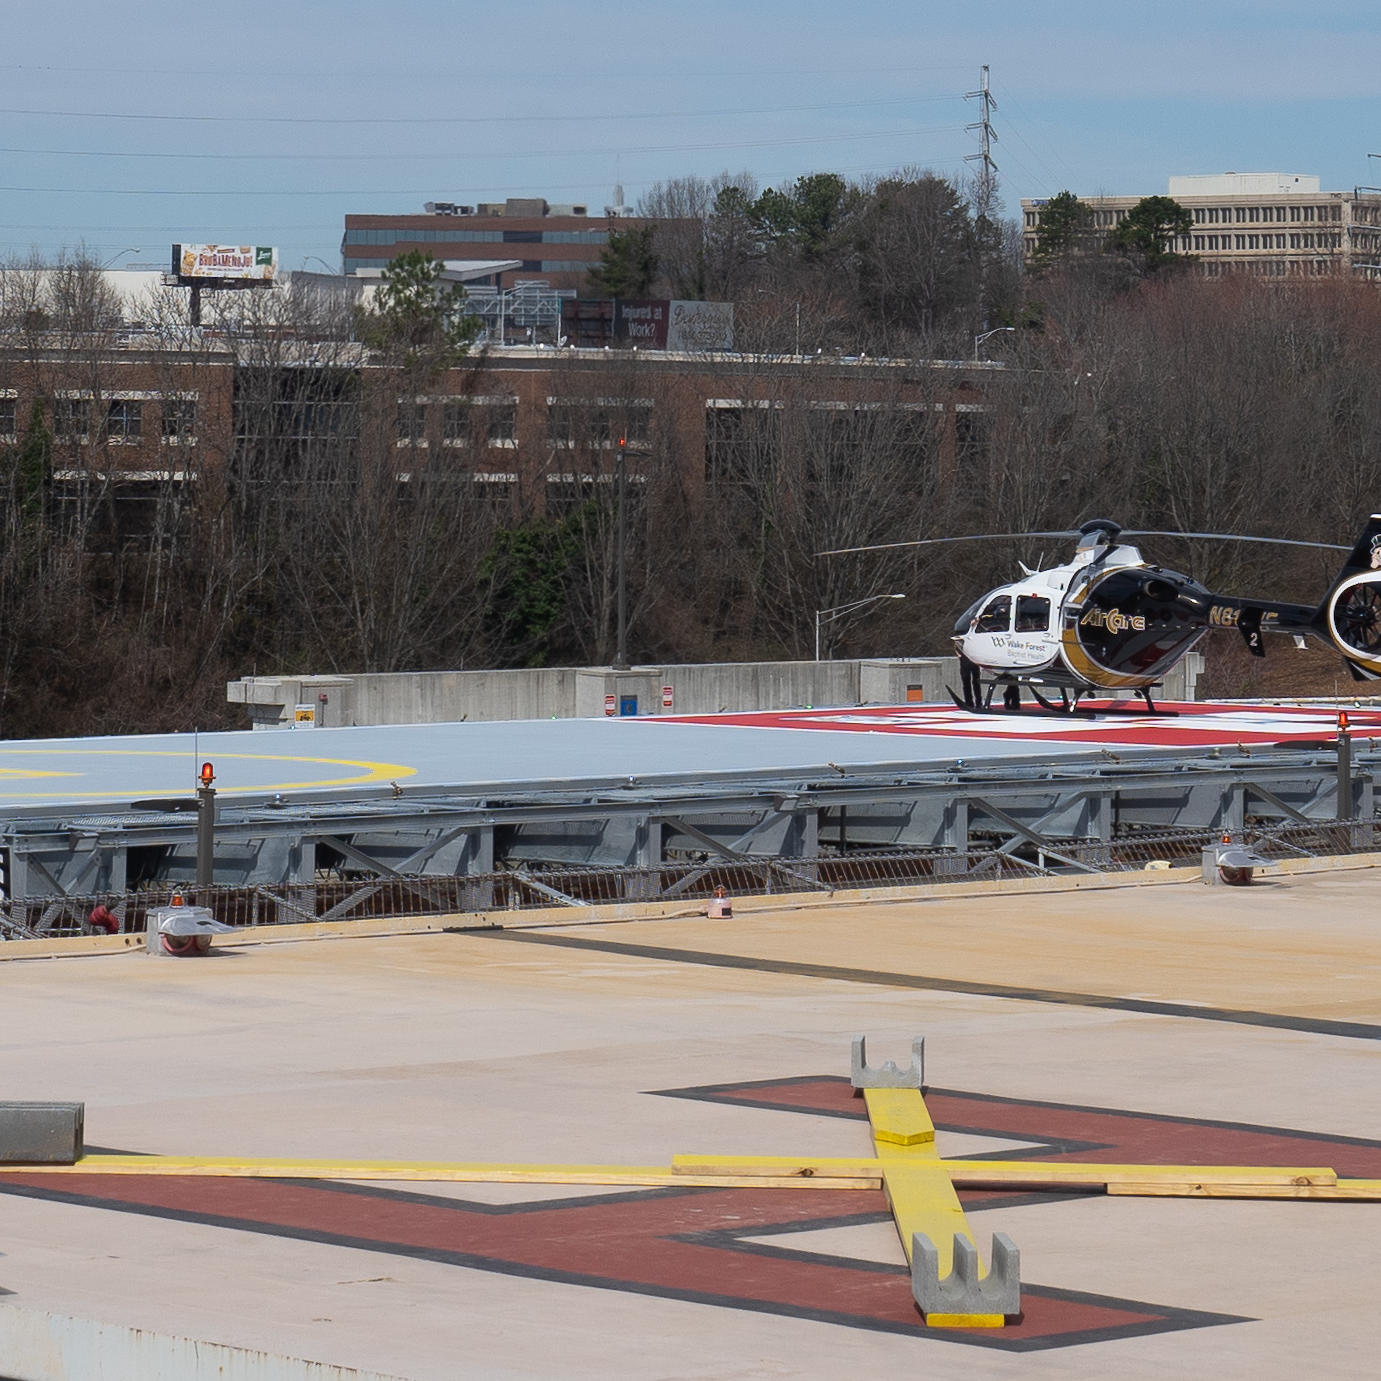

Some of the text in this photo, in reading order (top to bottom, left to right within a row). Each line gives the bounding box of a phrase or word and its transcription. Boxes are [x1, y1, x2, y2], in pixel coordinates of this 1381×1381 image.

[622, 305, 652, 321] Injured
[653, 307, 662, 320] at
[628, 323, 656, 337] Work?
[1080, 608, 1146, 634] AirCare
[1007, 640, 1046, 651] Wake Forest
[1250, 632, 1258, 647] 2
